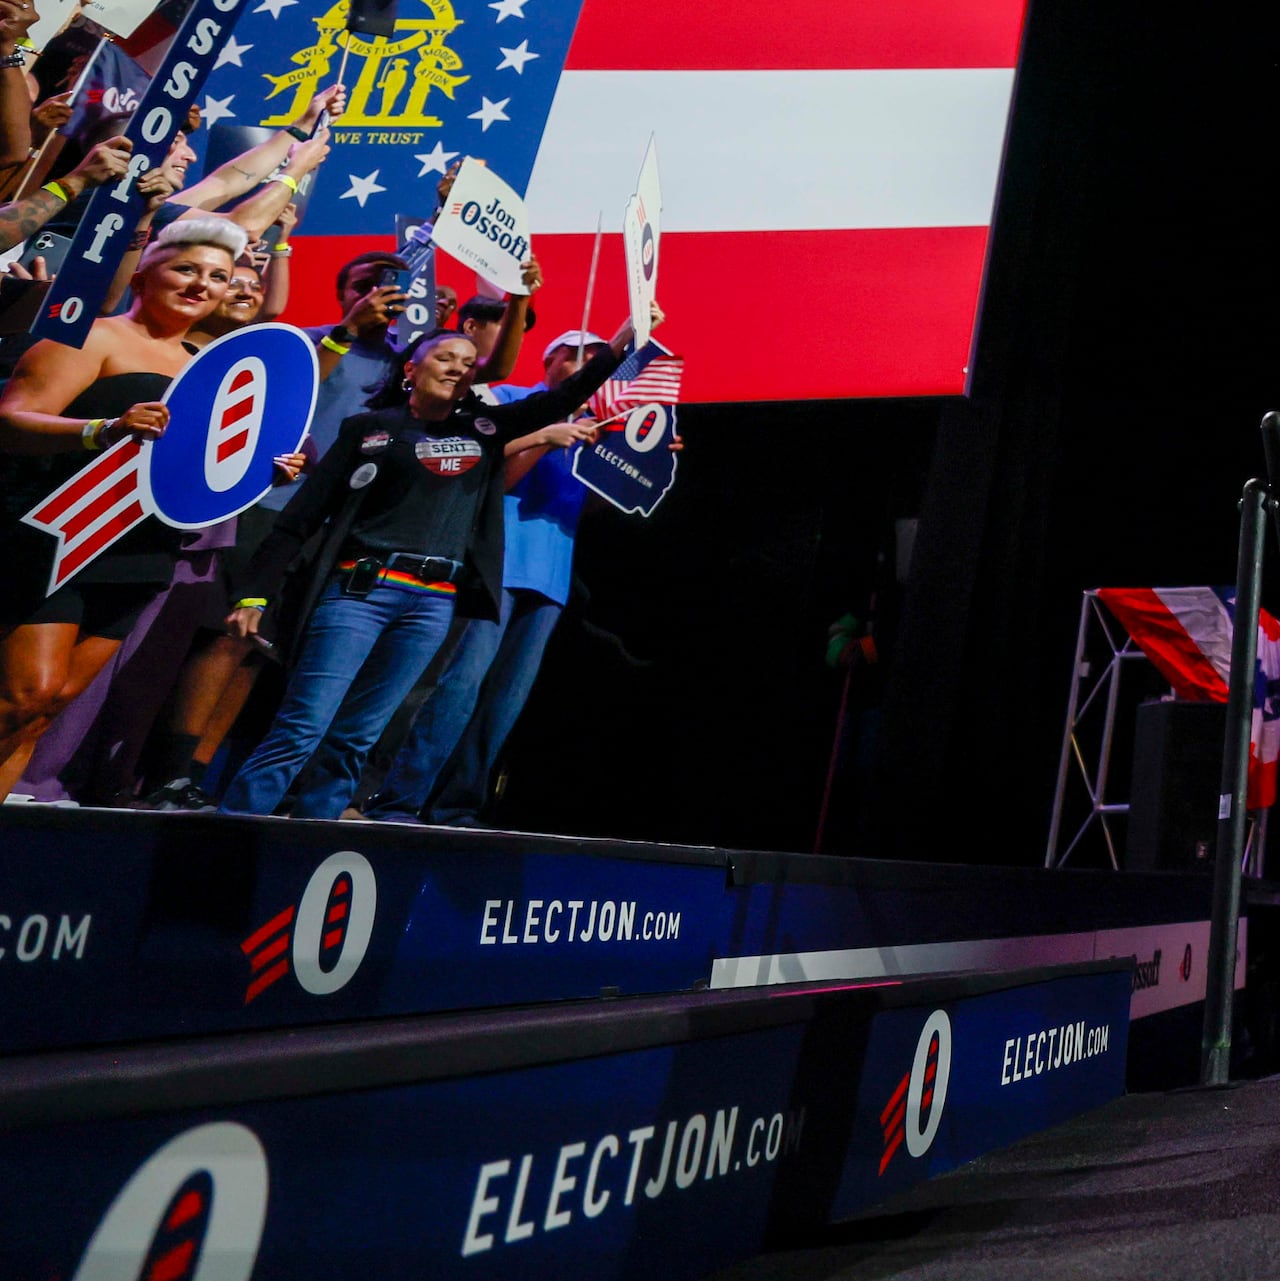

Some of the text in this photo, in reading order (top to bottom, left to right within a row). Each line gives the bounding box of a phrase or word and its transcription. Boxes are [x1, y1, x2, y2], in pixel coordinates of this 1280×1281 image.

[300, 47, 326, 60] WIS
[350, 41, 404, 56] JUSTICE
[287, 69, 318, 83] DOM
[418, 68, 450, 86] ATION
[334, 132, 425, 145] WE TRUST
[485, 197, 516, 231] Jon
[460, 200, 529, 262] Ossoff
[431, 443, 467, 453] SENT
[440, 458, 462, 472] ME
[479, 899, 681, 945] ELECTJON.COM
[1000, 1021, 1110, 1087] ELECTJON.COM
